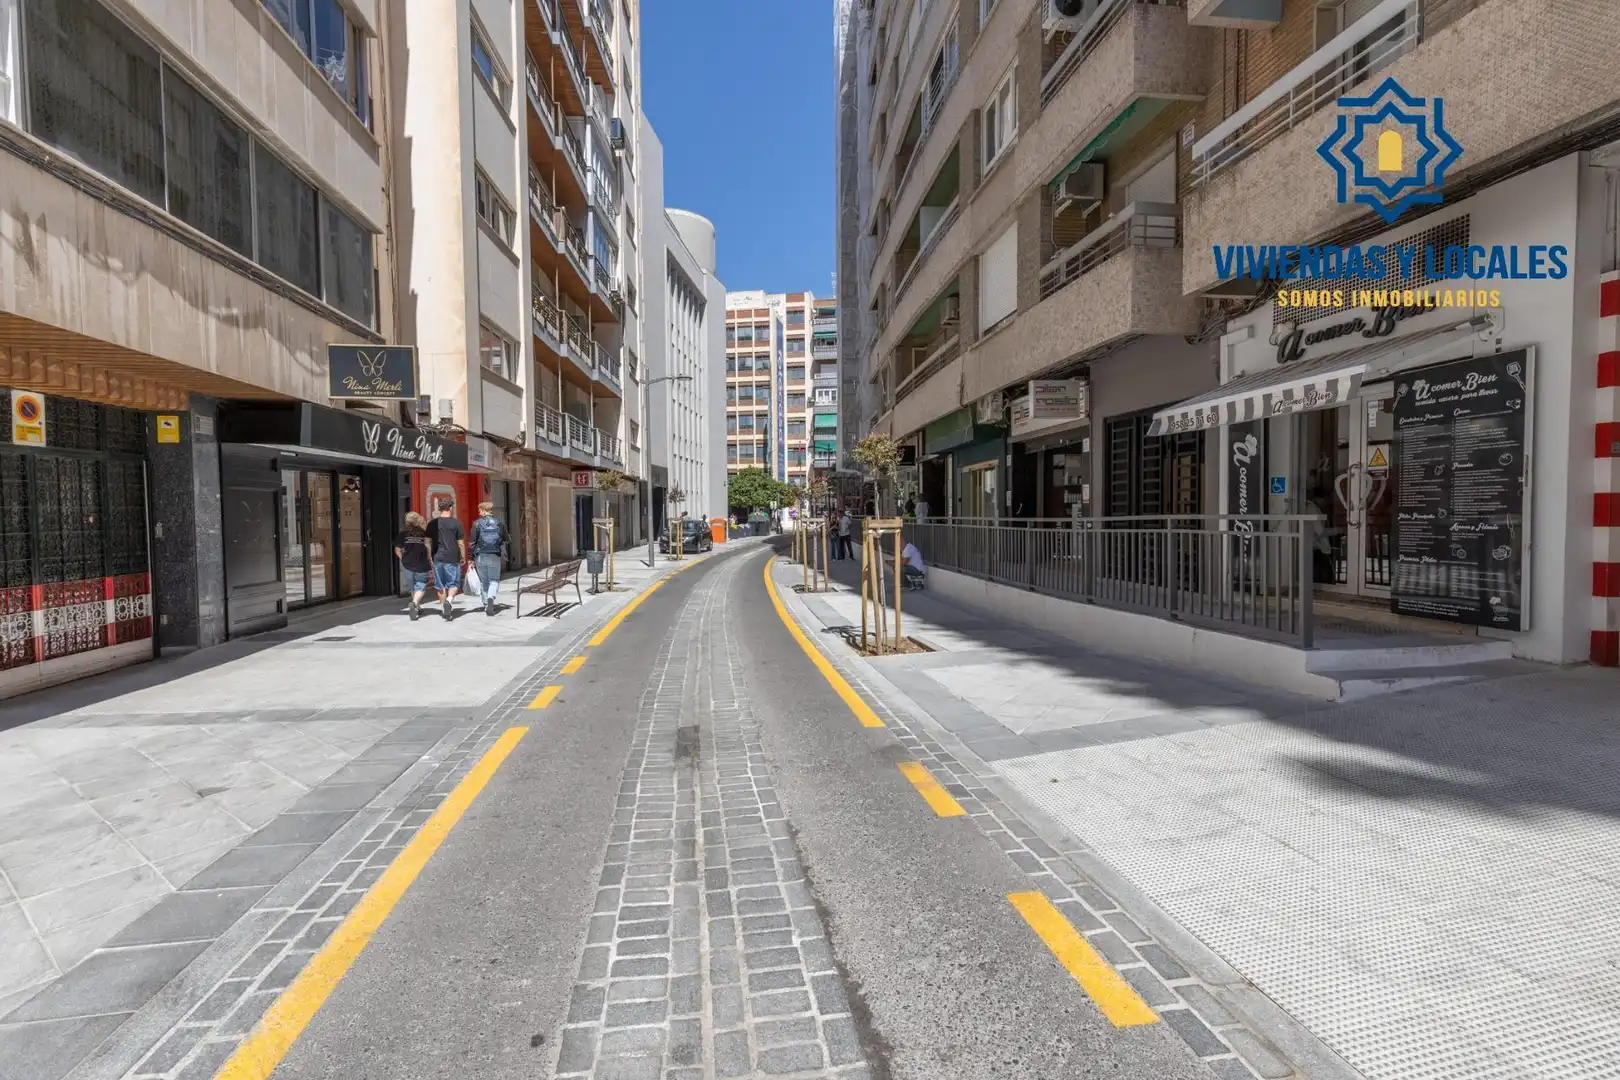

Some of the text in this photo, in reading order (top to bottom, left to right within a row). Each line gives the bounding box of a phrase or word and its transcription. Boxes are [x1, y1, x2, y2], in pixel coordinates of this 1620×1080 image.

[1305, 317, 1366, 346] comer
[342, 376, 370, 391] Nina
[1430, 379, 1463, 392] comer
[1461, 372, 1498, 391] Bien
[1282, 398, 1306, 408] comer
[1304, 390, 1333, 407] Bien
[1170, 413, 1217, 430] 958 25 11 60
[387, 427, 416, 460] Nina
[1239, 466, 1248, 515] comer
